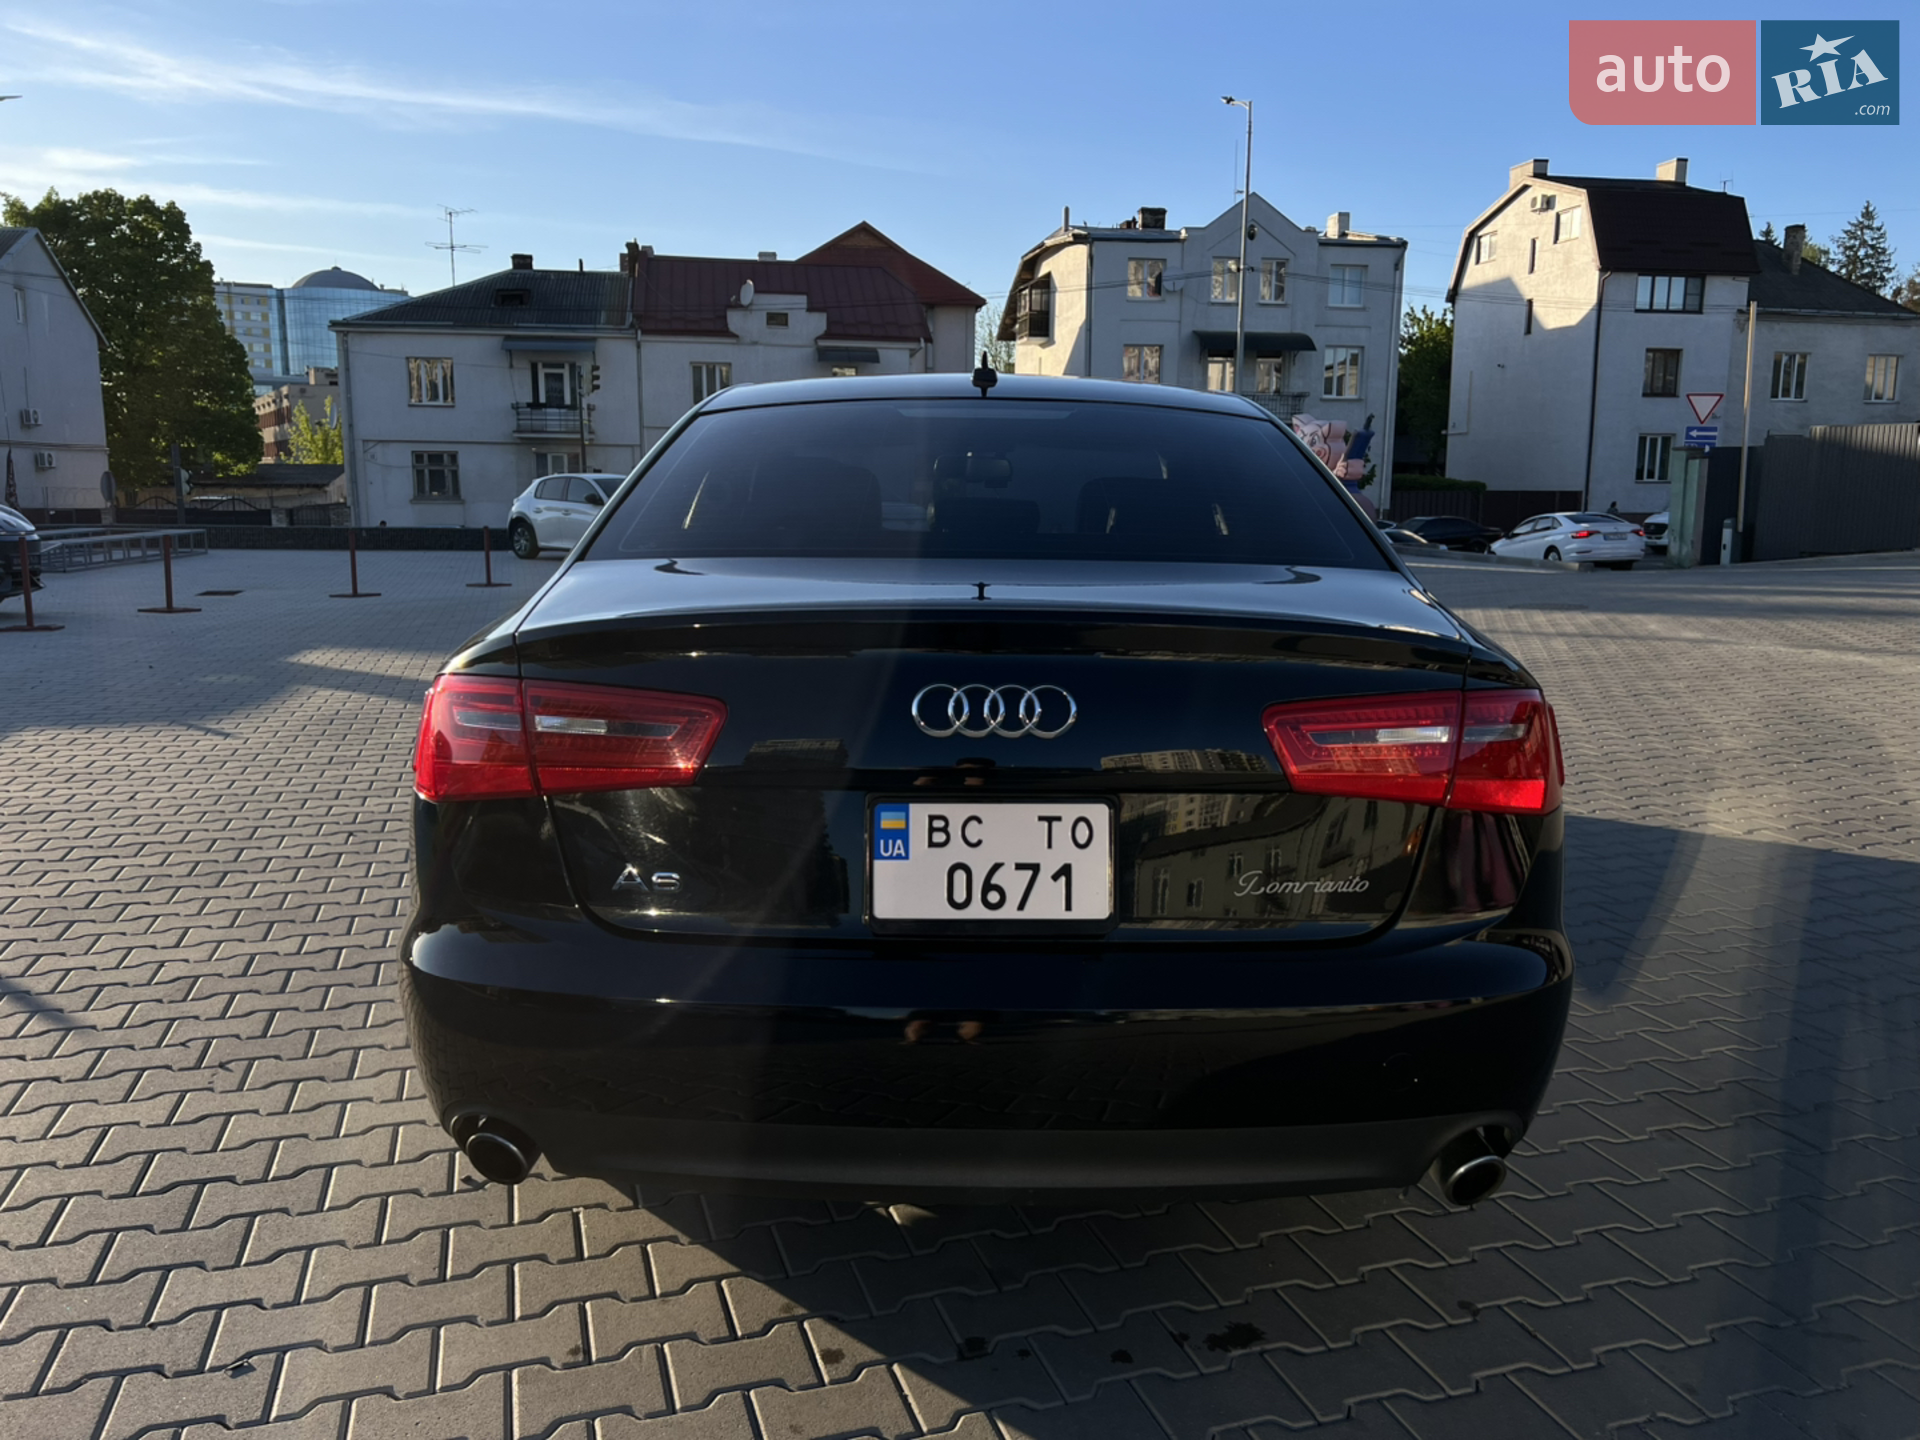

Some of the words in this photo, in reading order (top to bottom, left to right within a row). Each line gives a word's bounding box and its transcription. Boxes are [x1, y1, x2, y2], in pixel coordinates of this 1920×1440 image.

[880, 839, 906, 857] UA
[927, 814, 984, 849] BC
[1037, 815, 1094, 850] TO
[946, 861, 1073, 912] 0671
